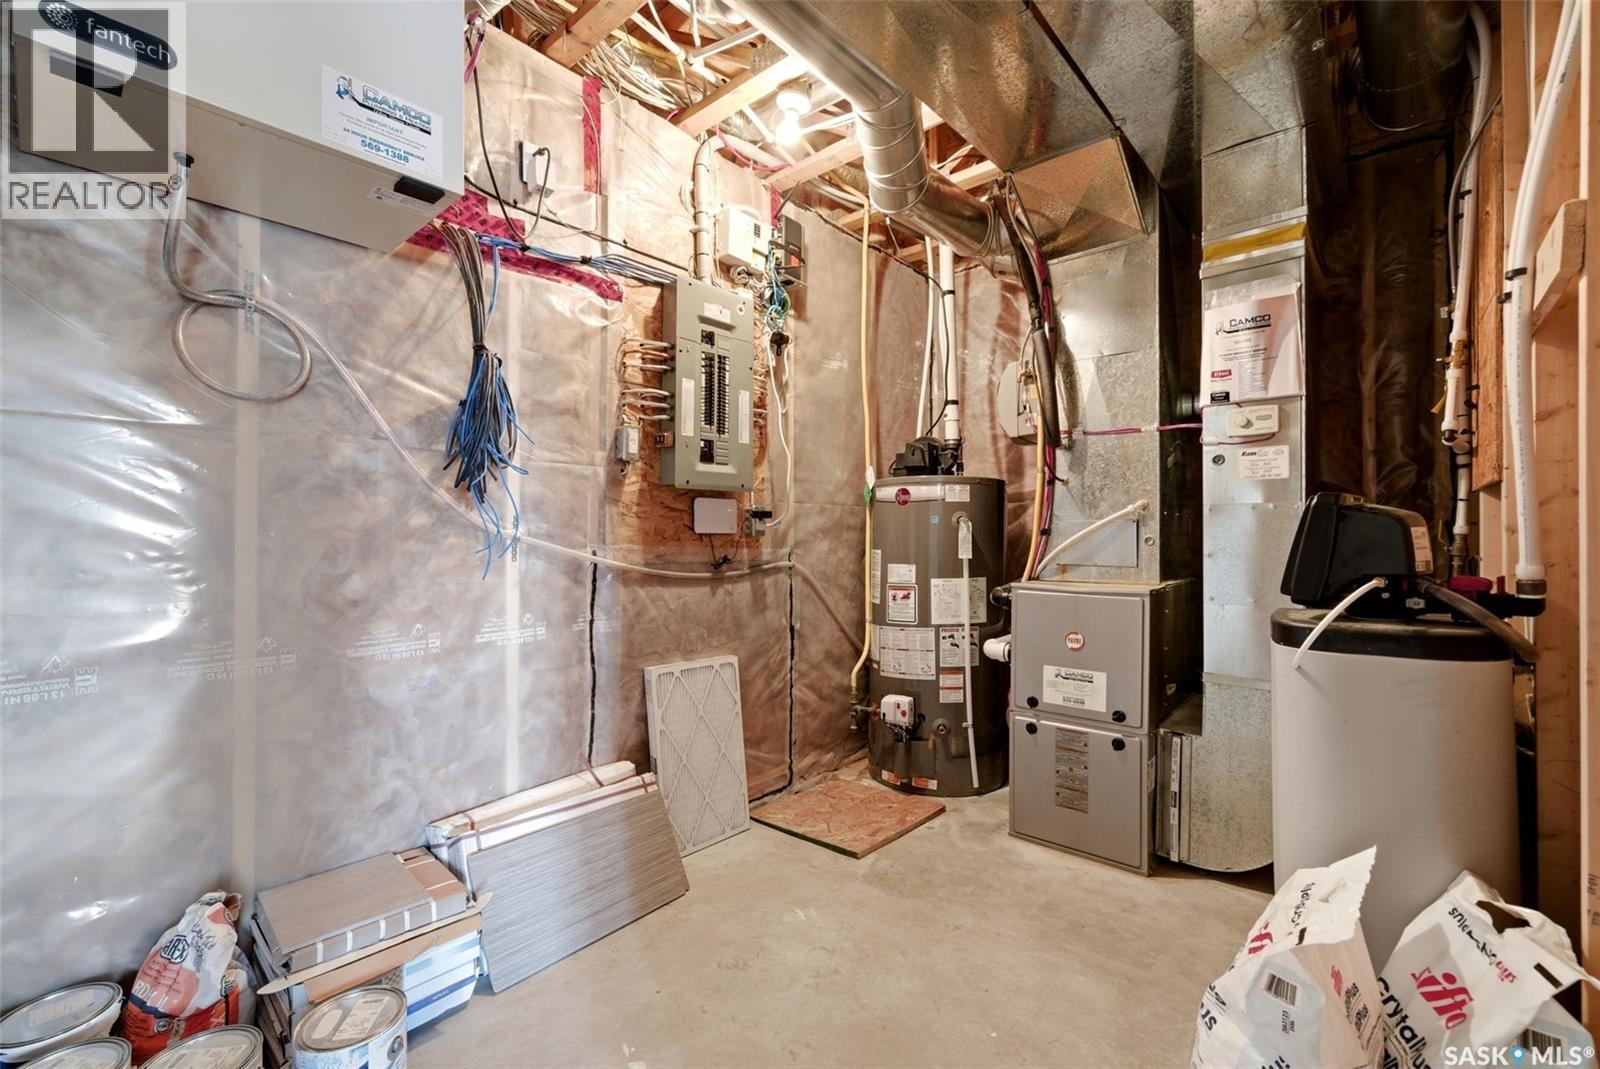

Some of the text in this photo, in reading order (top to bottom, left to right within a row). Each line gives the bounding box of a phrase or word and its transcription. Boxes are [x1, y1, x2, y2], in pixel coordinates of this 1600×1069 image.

[86, 17, 171, 64] fantech
[362, 85, 432, 126] CAMCO
[361, 139, 409, 164] 569-1388
[1229, 313, 1271, 327] CAMCO
